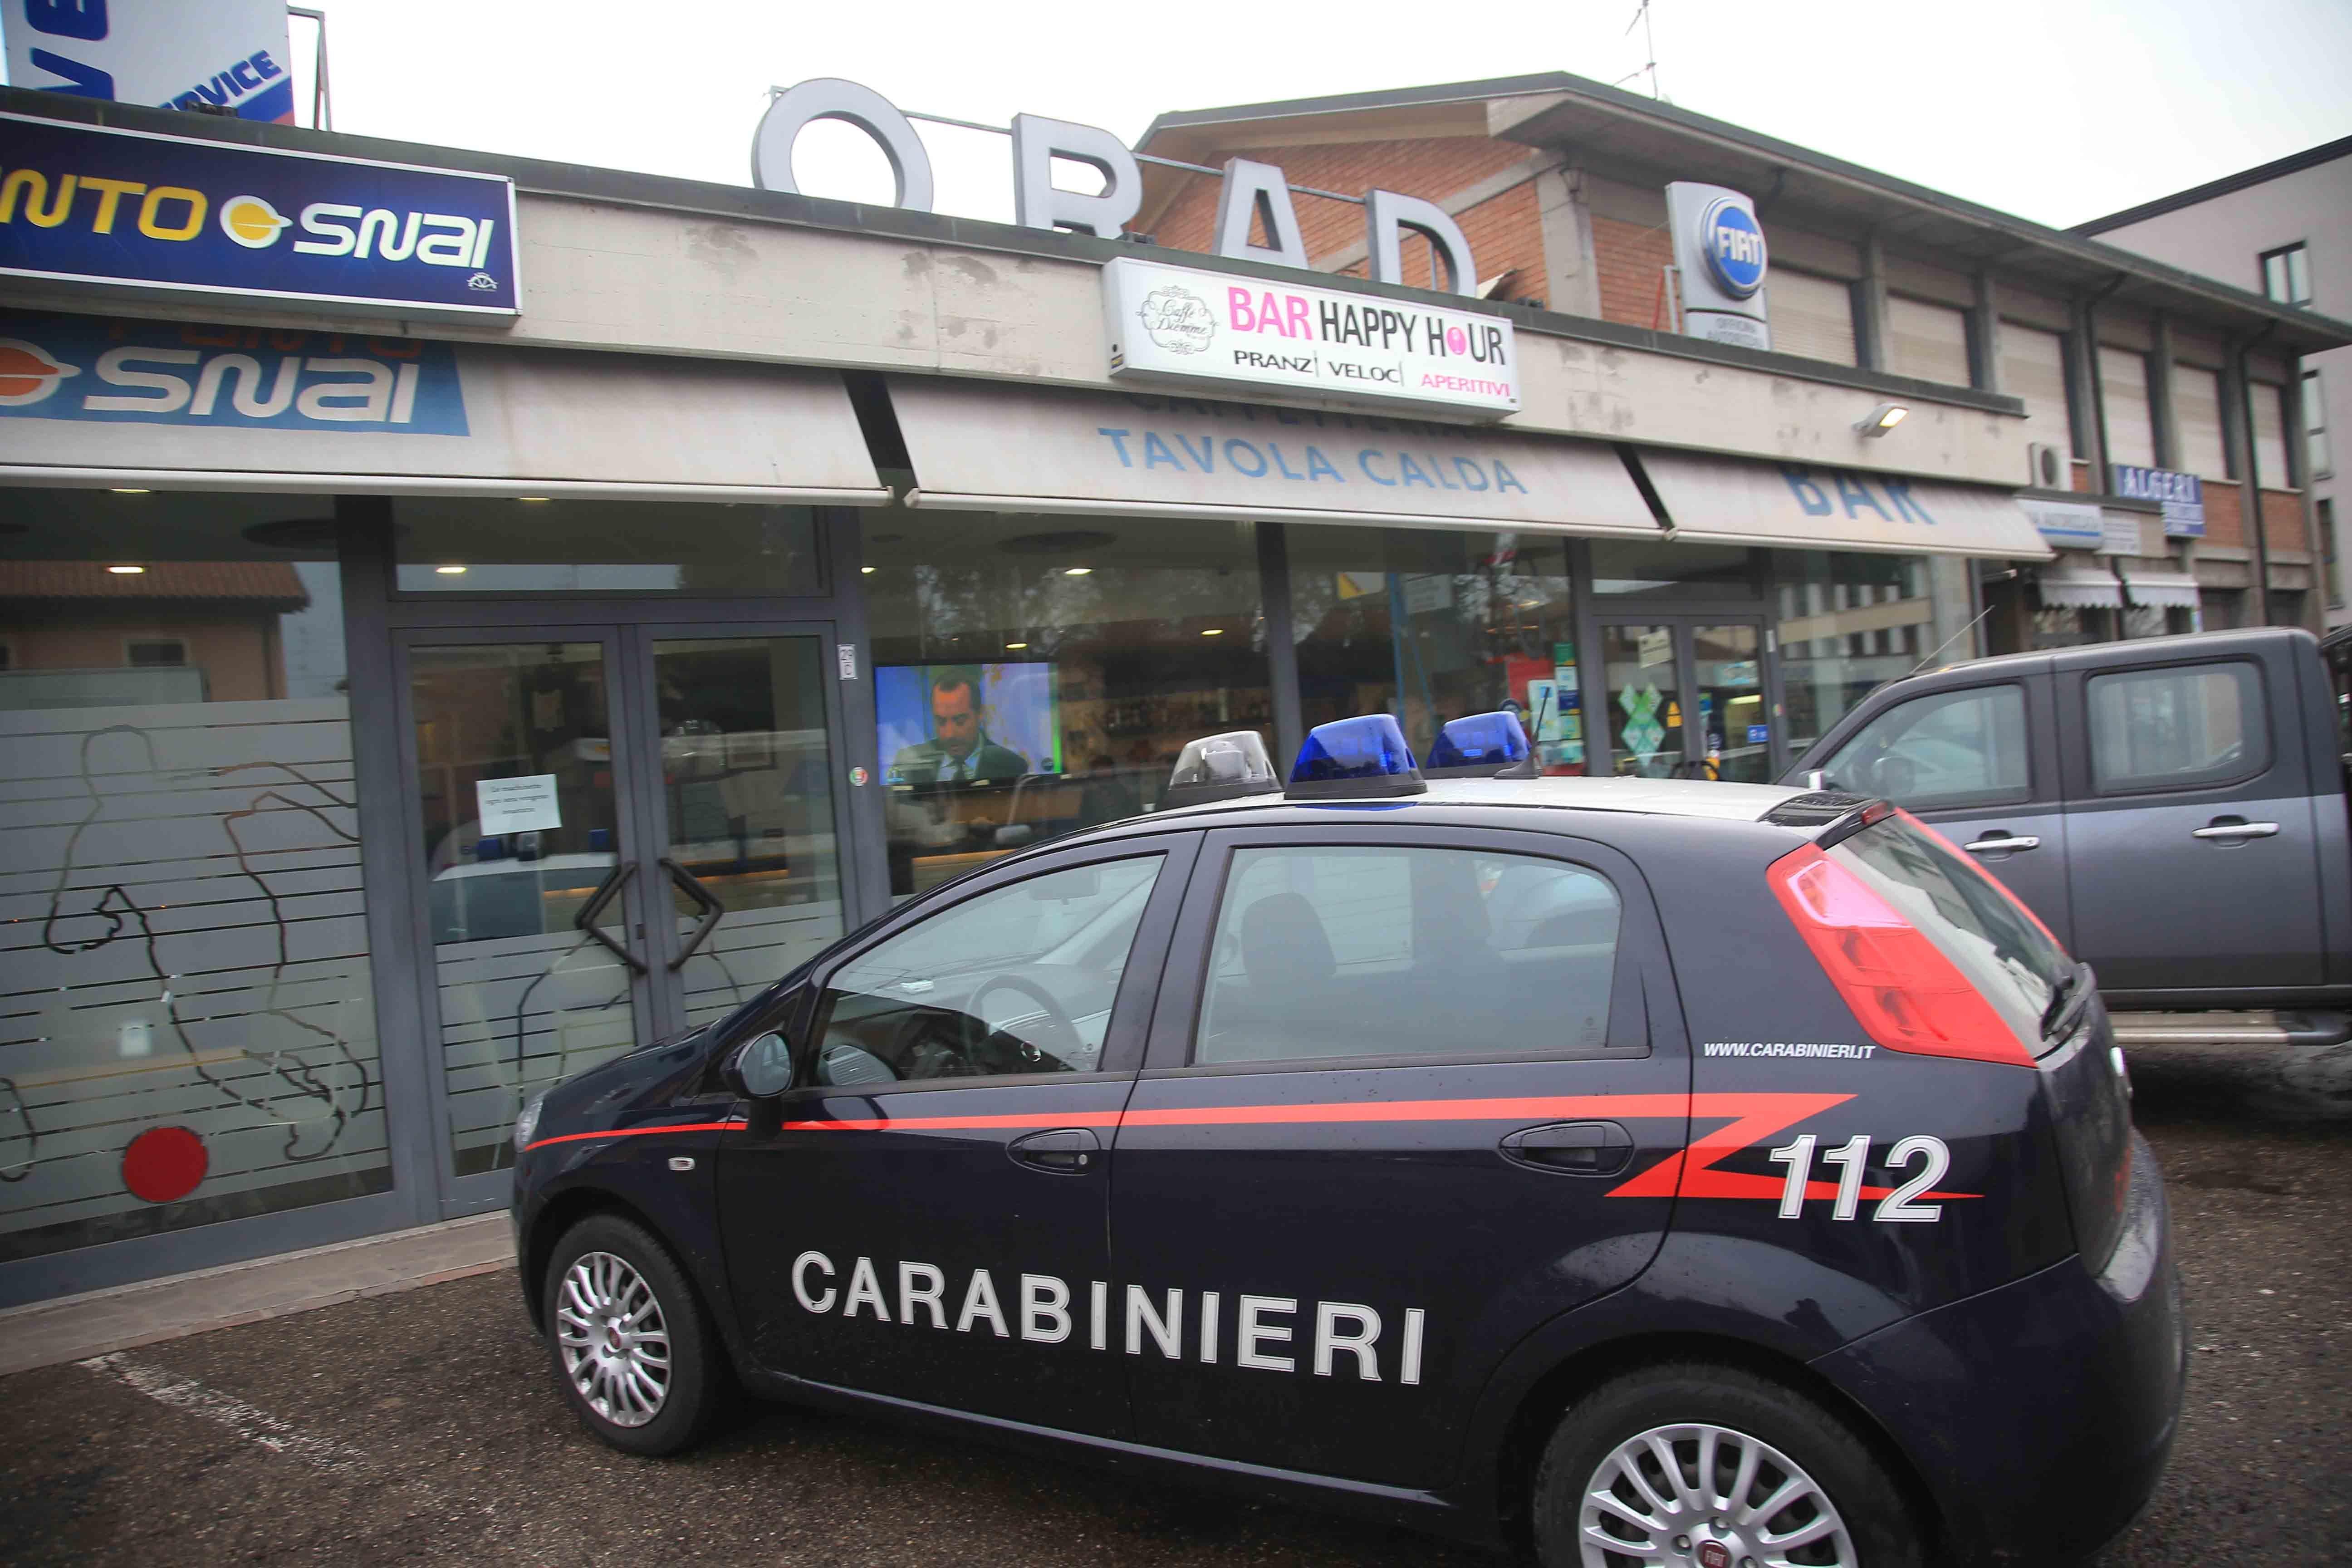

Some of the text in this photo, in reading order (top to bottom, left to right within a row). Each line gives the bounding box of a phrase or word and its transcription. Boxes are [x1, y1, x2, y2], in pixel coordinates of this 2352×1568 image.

[0, 169, 209, 241] NTO
[1717, 226, 1762, 265] FIAT
[1227, 286, 1506, 365] BAR HAPPY HOUR
[1420, 373, 1510, 397] APERITIVI
[1098, 428, 1528, 495] TAVOLA CALDA
[1704, 1042, 1876, 1060] WWW.CARABINIERI.IT
[1769, 1134, 1950, 1222] 112
[792, 1251, 1424, 1384] CARABINIERI
